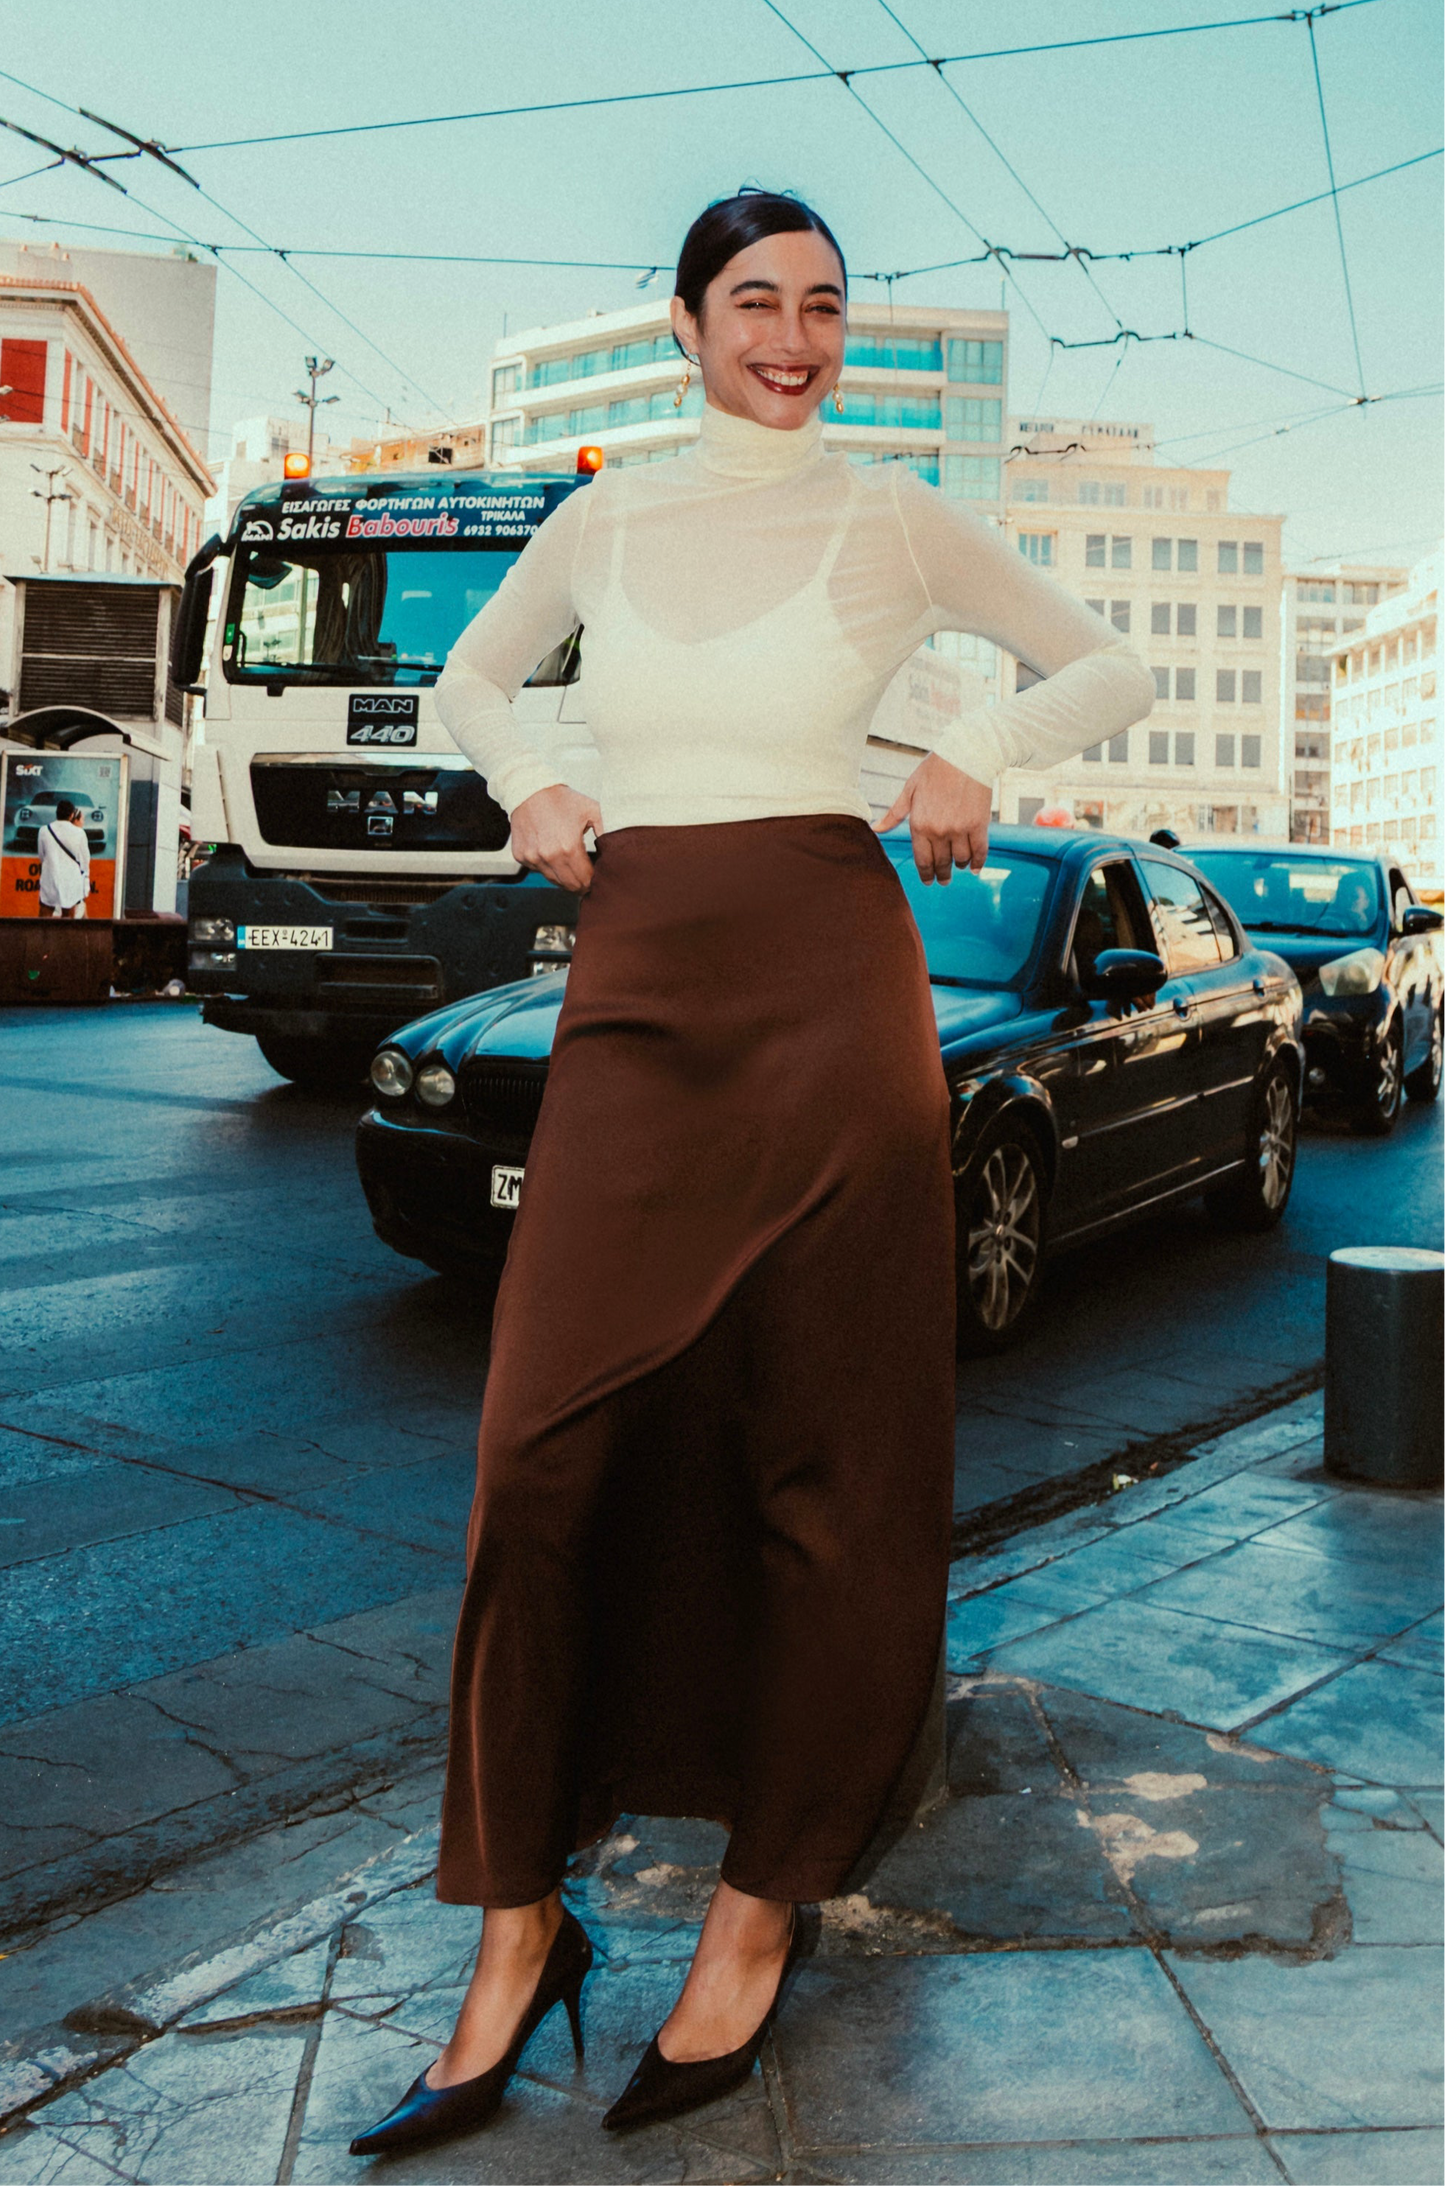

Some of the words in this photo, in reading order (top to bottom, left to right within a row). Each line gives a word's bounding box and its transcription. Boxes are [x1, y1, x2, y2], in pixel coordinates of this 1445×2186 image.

[281, 499, 352, 514] ΕΙΣΑΓΩΓΕΣ
[355, 497, 436, 512] ΦΟΡΤΗΓΩΝ
[437, 496, 546, 510] ΑΥΤΟΚΙΝΗΤΩΝ
[481, 510, 526, 521] ΤΡΙΚΑΛΑ
[276, 515, 341, 541] Sakis
[345, 511, 460, 539] Babouris
[463, 524, 492, 536] 6932
[353, 697, 414, 714] MAN
[350, 724, 416, 743] 440
[327, 790, 439, 815] MAN
